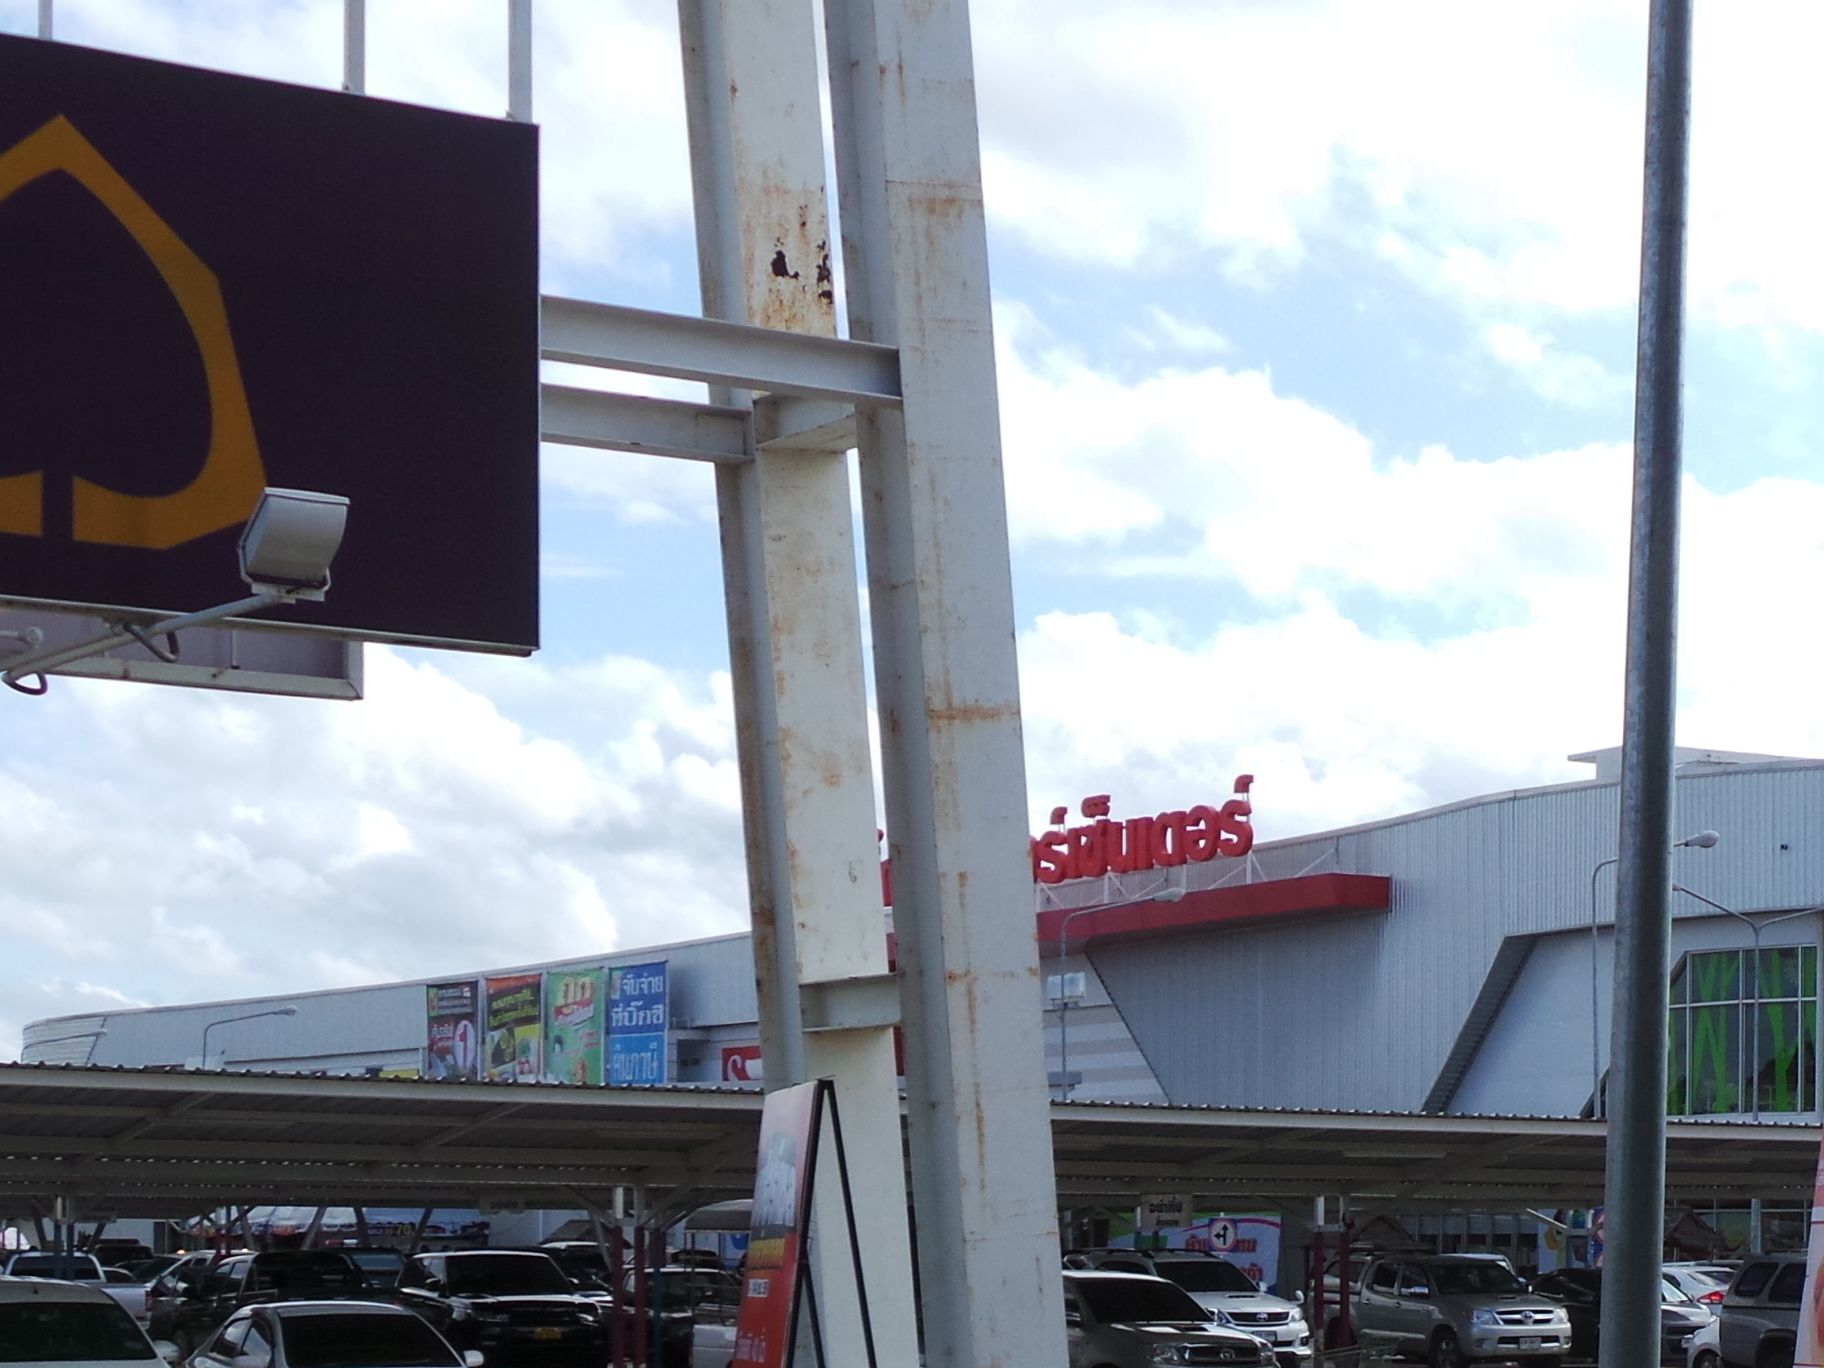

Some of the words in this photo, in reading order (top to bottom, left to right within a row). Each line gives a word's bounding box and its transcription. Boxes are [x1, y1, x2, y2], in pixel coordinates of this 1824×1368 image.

[1031, 774, 1255, 885] ร์เซ็นเตอร์
